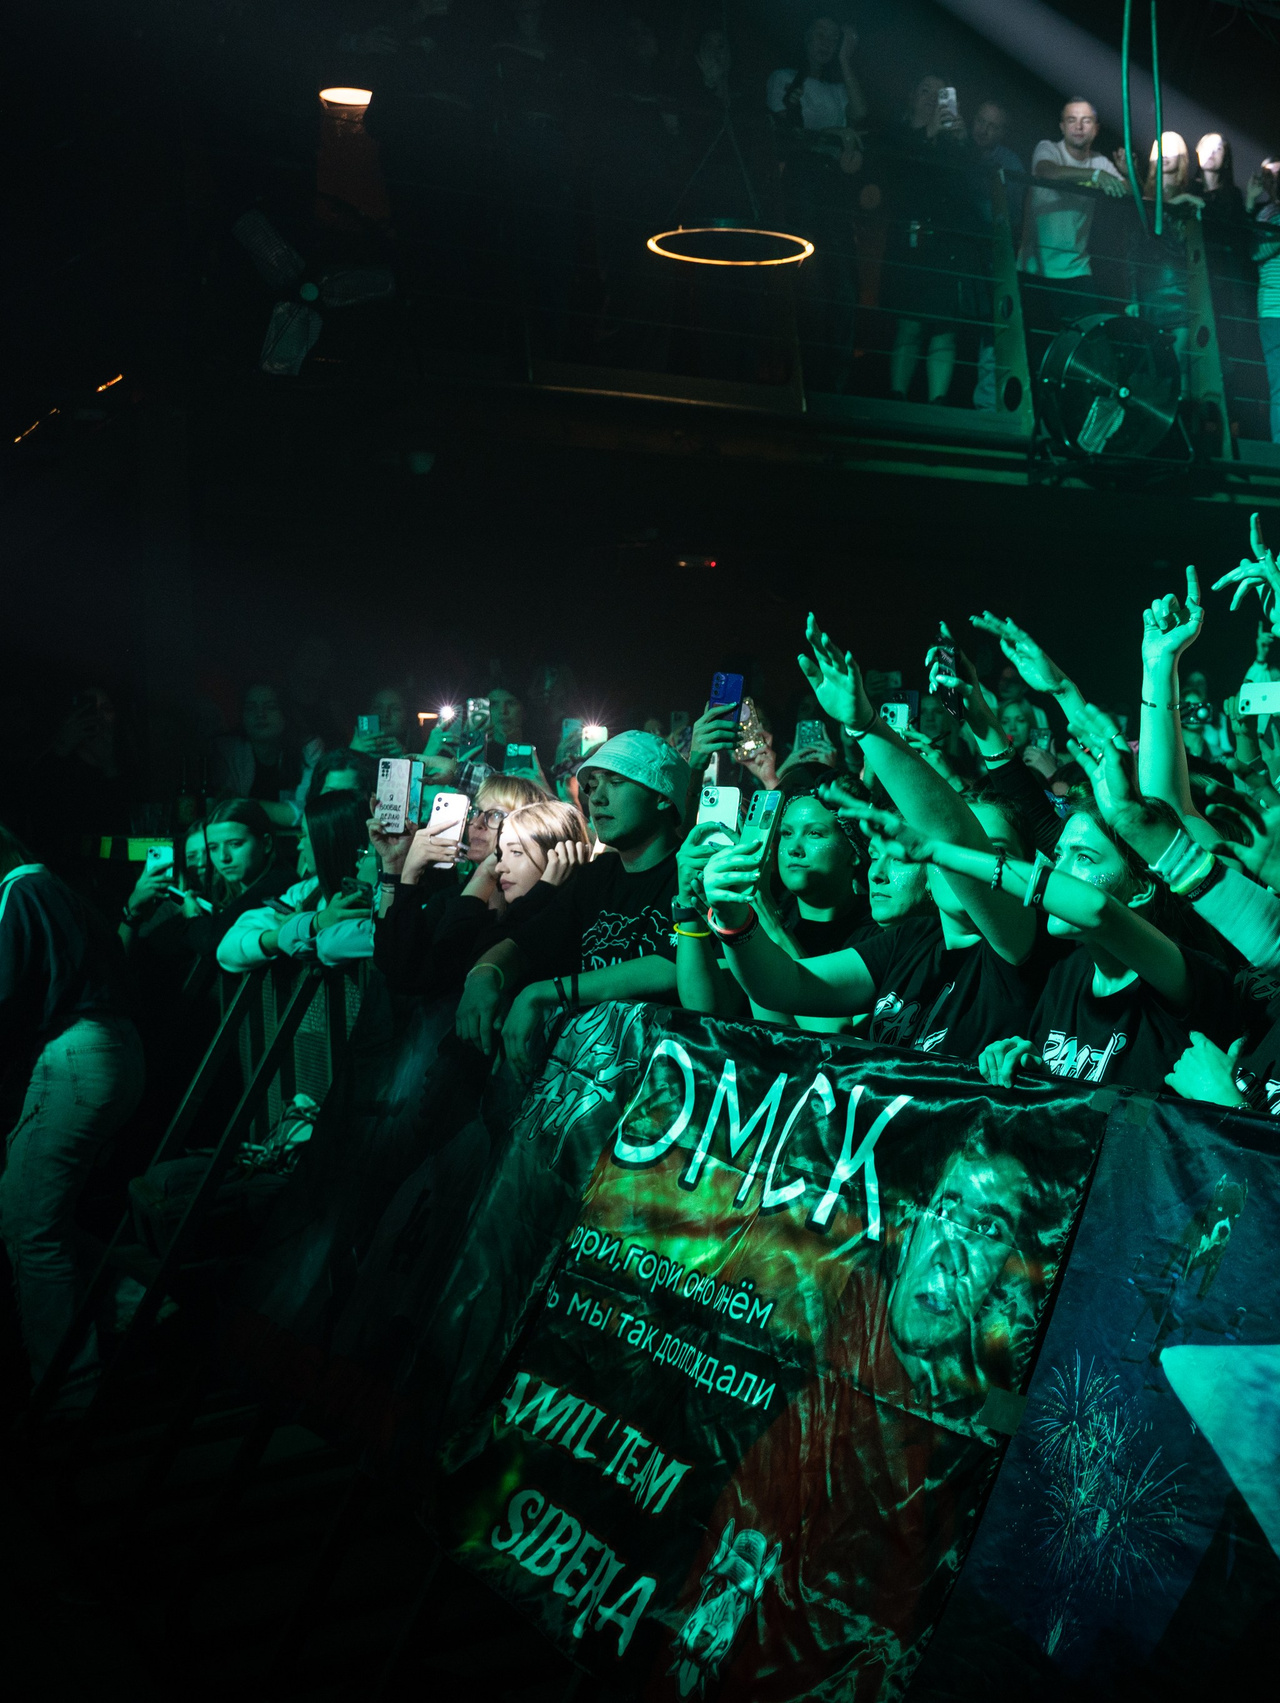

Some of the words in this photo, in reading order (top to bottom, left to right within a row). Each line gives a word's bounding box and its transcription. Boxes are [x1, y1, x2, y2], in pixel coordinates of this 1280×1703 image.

[1187, 886, 1203, 899] 2024
[613, 1038, 915, 1242] ОМСК
[566, 1292, 613, 1331] мы
[618, 1311, 660, 1353] так
